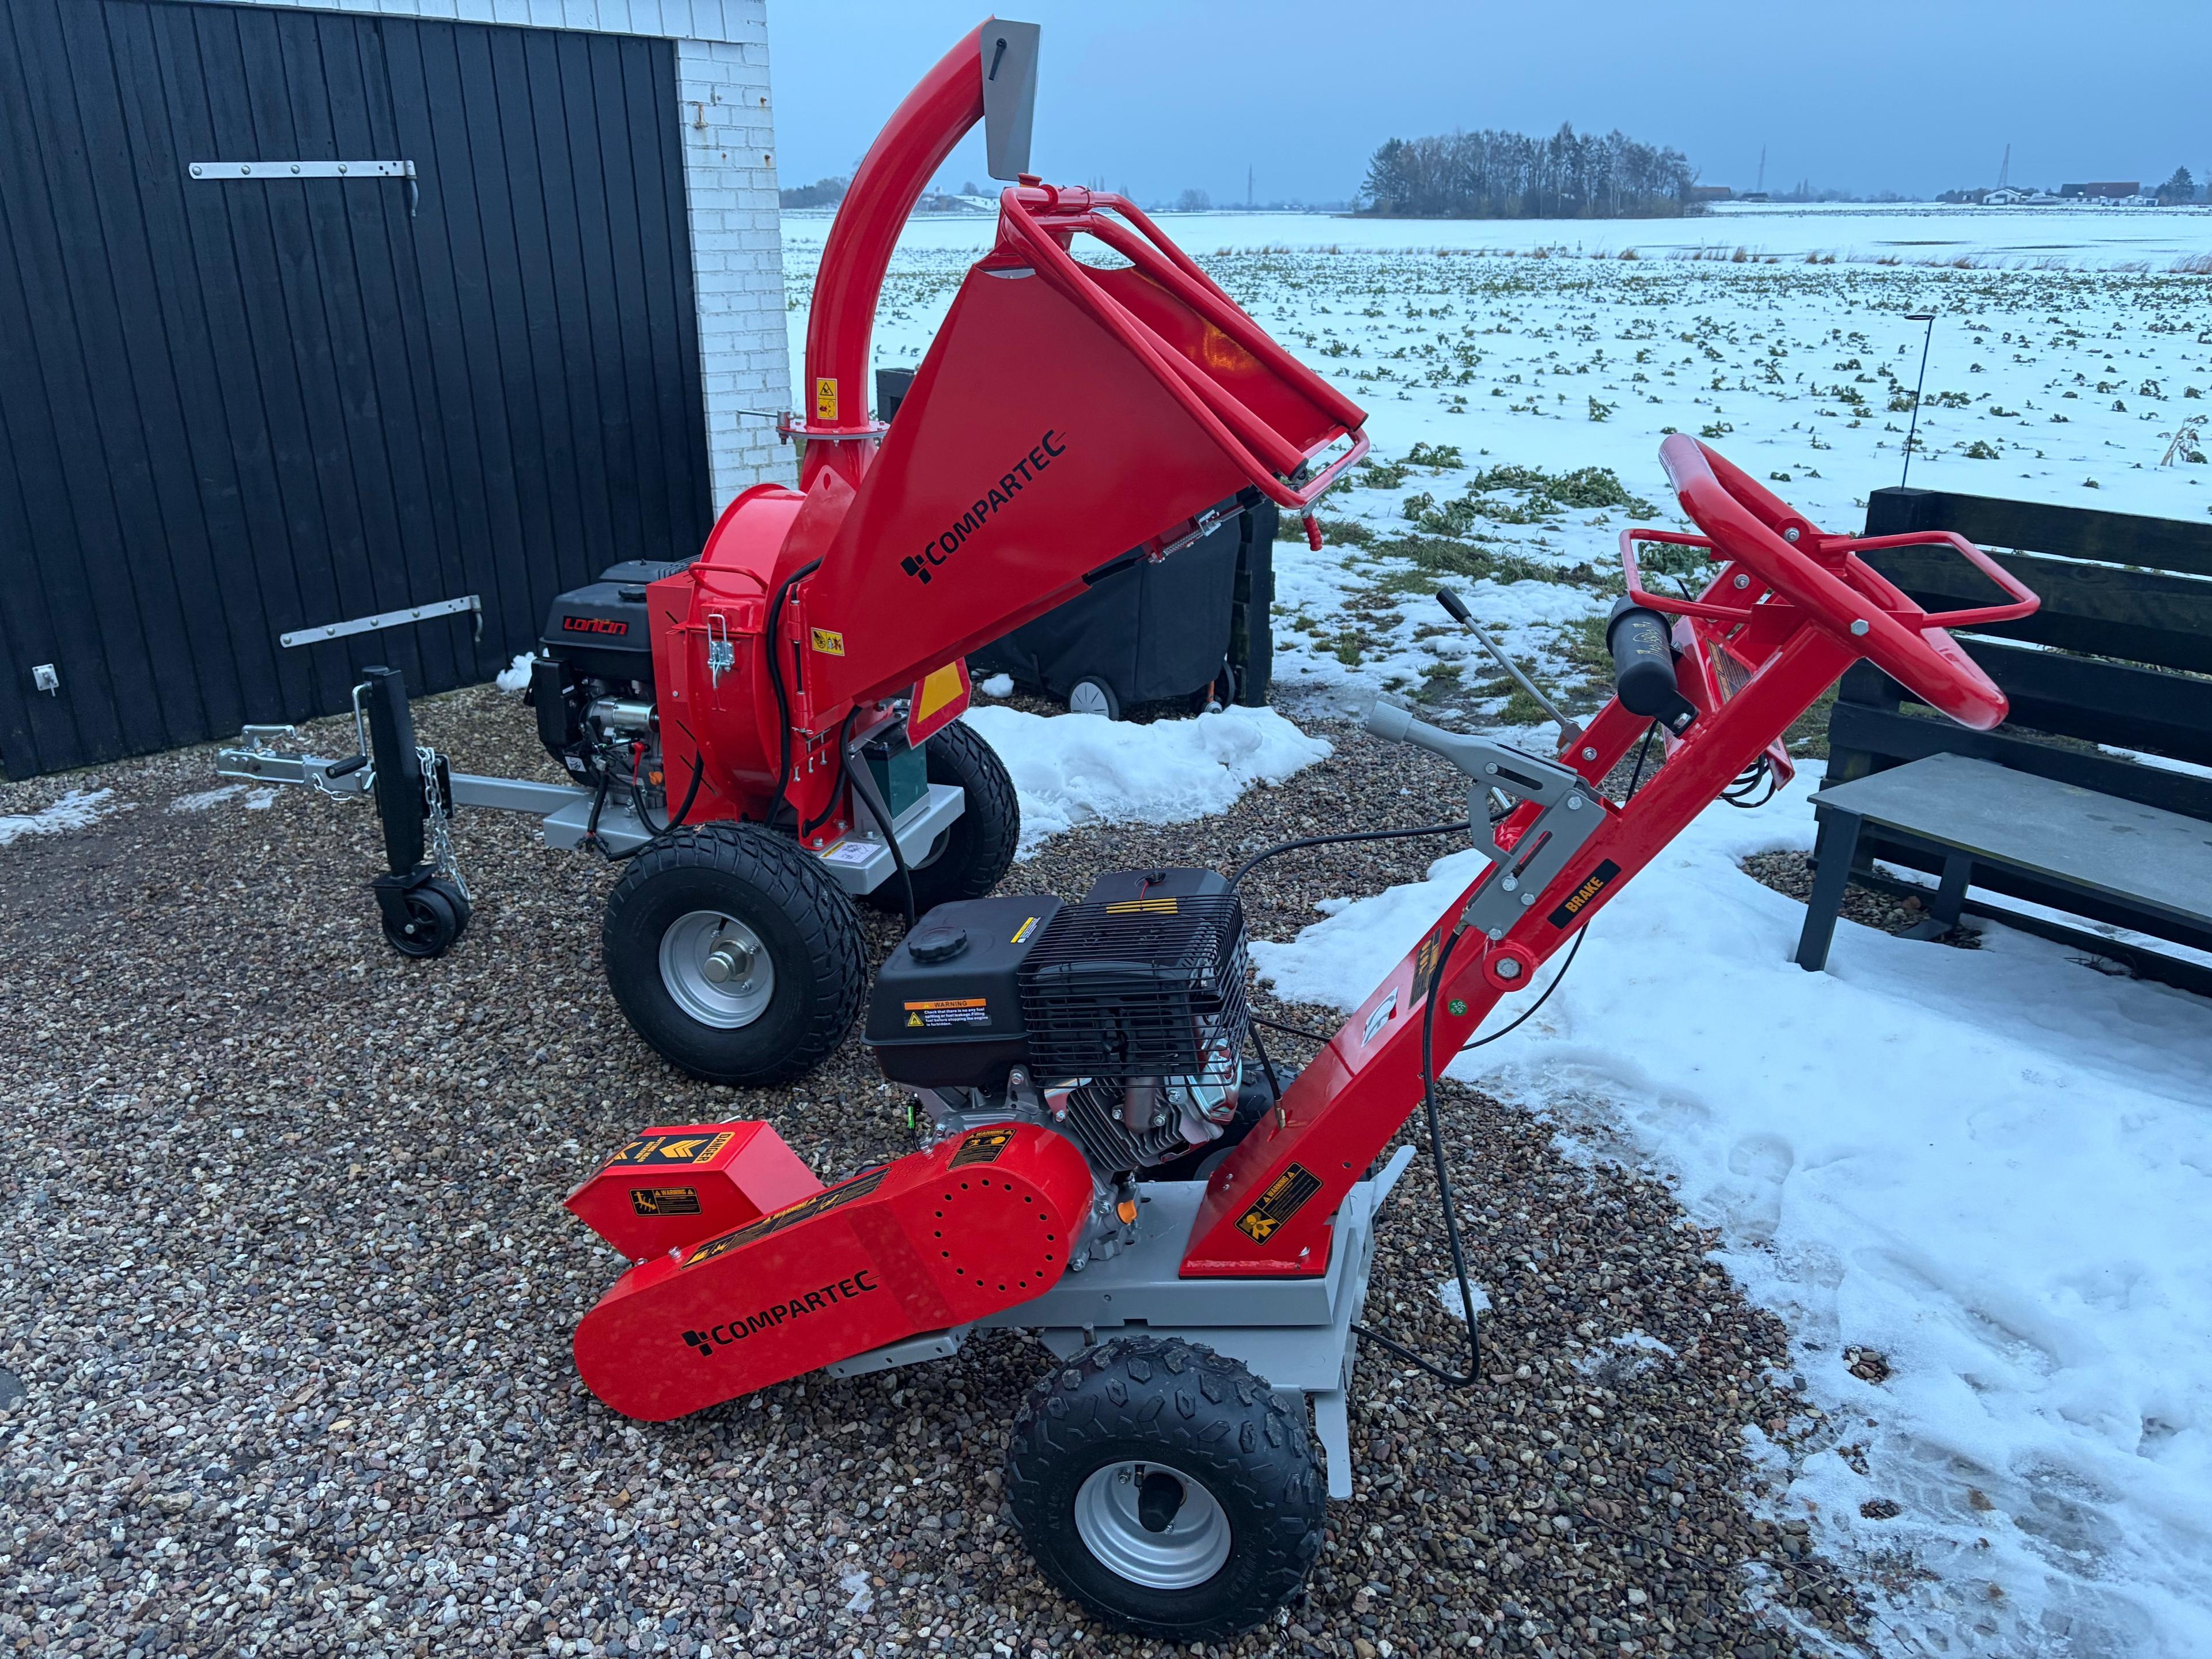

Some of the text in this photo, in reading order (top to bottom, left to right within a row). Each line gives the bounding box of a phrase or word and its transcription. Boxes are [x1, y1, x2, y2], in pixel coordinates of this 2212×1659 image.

[925, 430, 1066, 566] COMPARTEC
[1565, 876, 1604, 913] BRAKE
[696, 1134, 732, 1161] DANGER
[1267, 1176, 1290, 1197] WARNING
[711, 1270, 878, 1345] COMPARTEC
